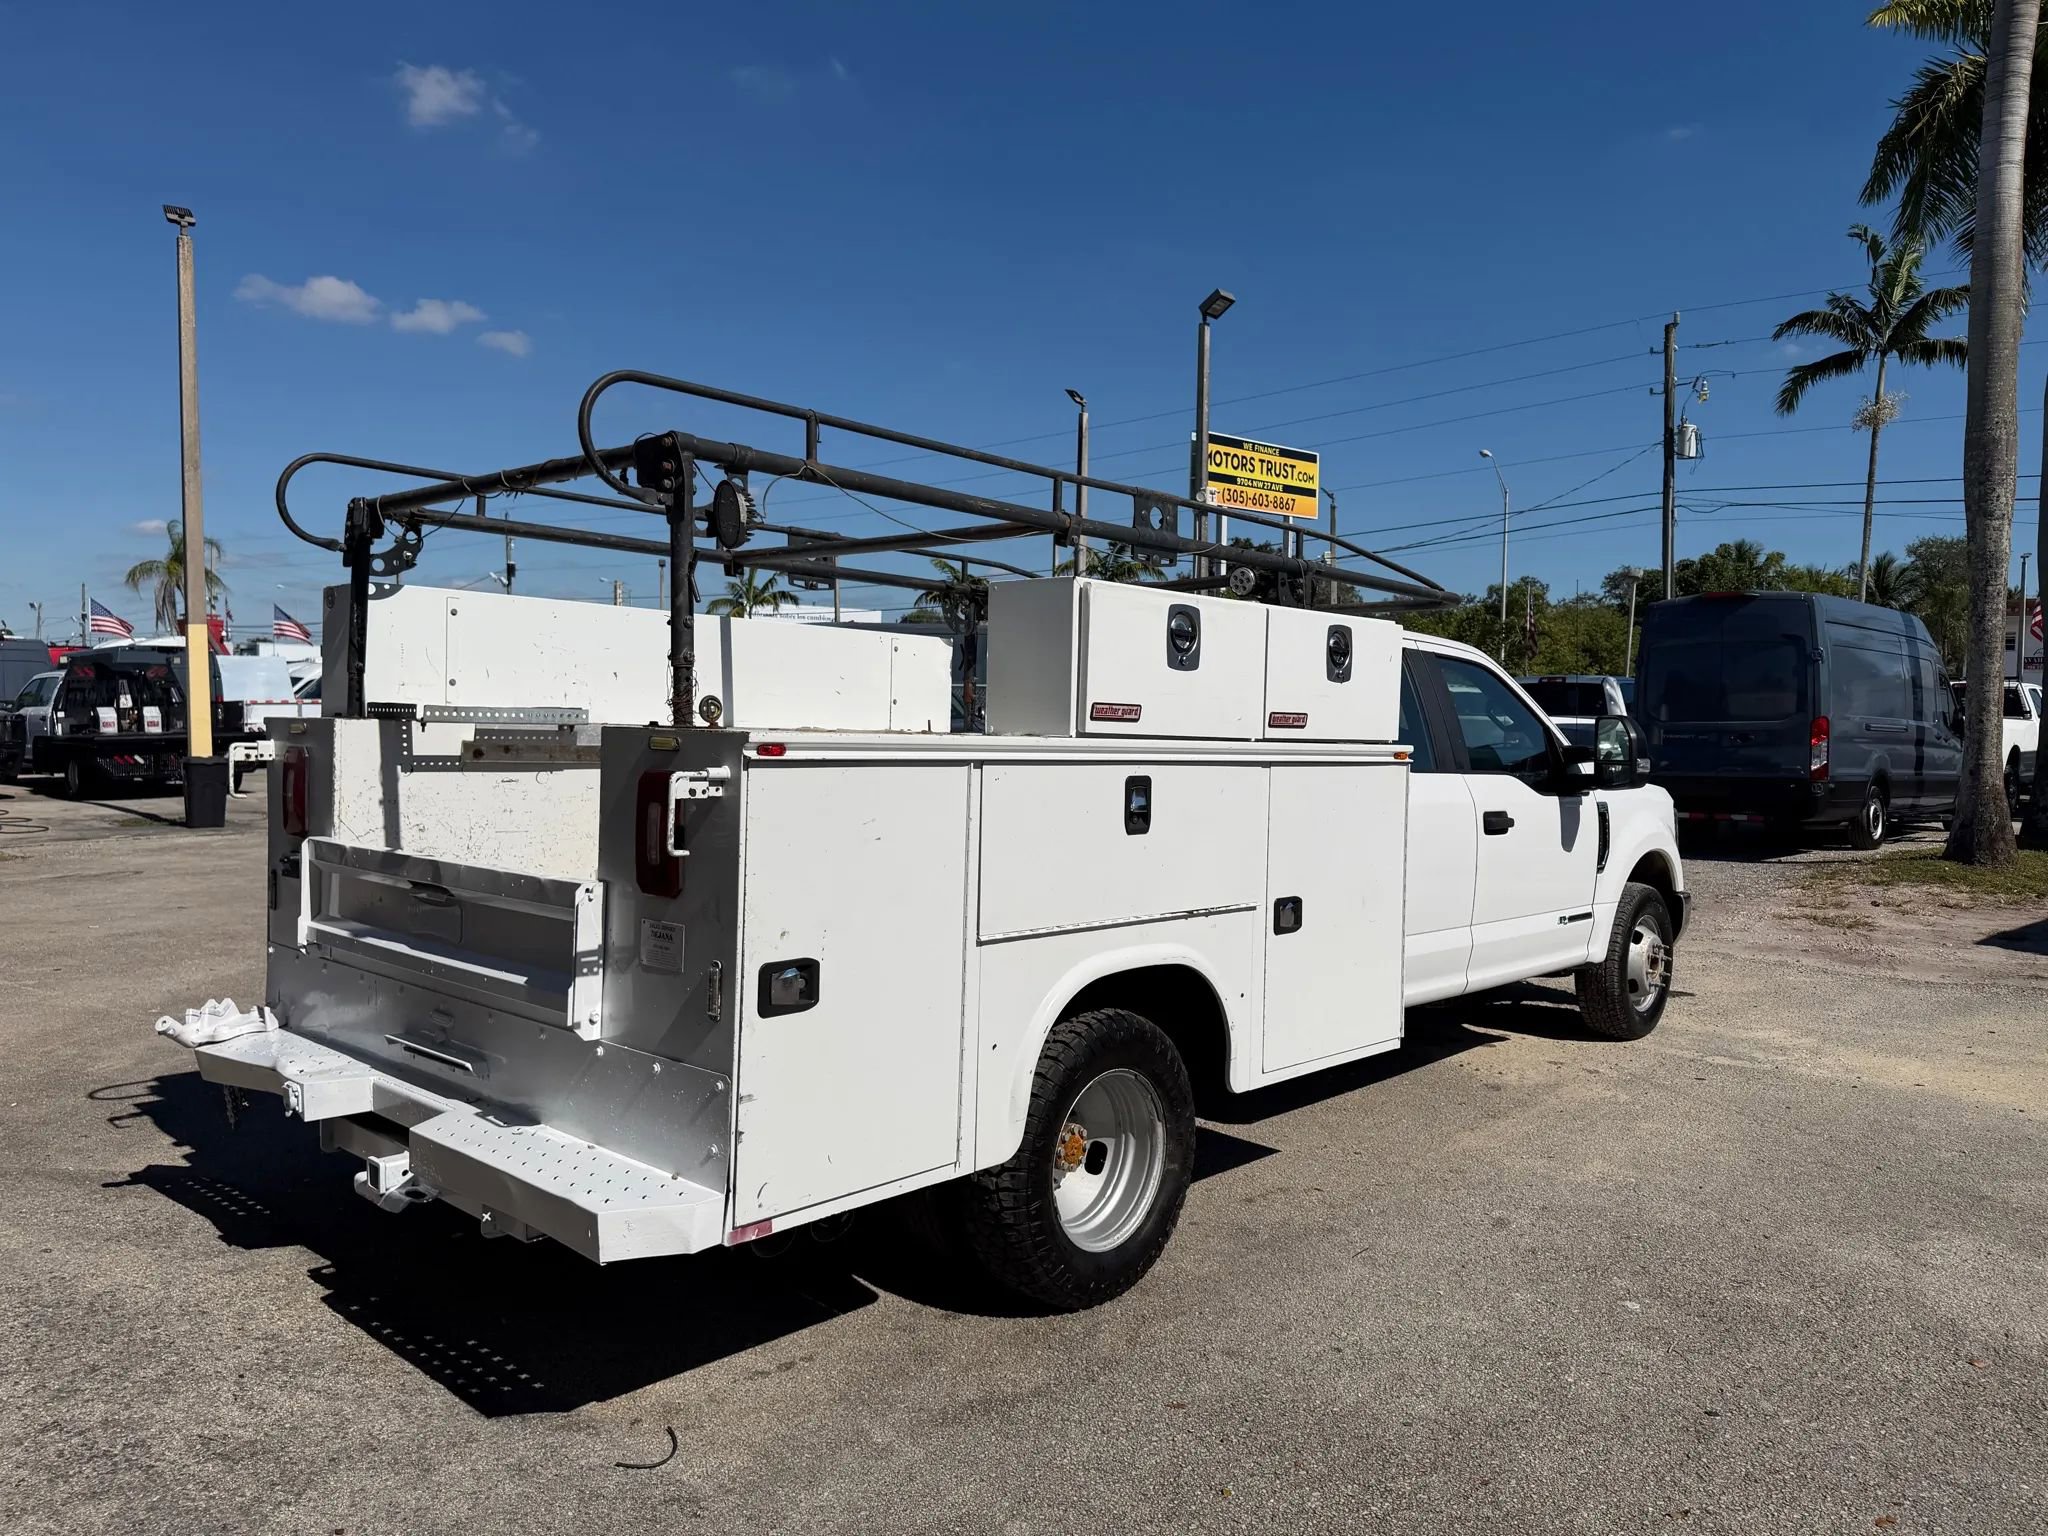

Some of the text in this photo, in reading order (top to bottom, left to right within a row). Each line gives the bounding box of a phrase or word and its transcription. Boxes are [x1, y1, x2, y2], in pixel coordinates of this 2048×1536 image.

[1243, 442, 1280, 456] WE FINANCE
[1258, 458, 1315, 485] TRUST.COM
[1252, 480, 1264, 489] NW
[1264, 482, 1271, 490] 27
[1271, 483, 1284, 492] AVE
[1222, 488, 1296, 511] (305)-603-8867
[1095, 706, 1139, 717] weather guard
